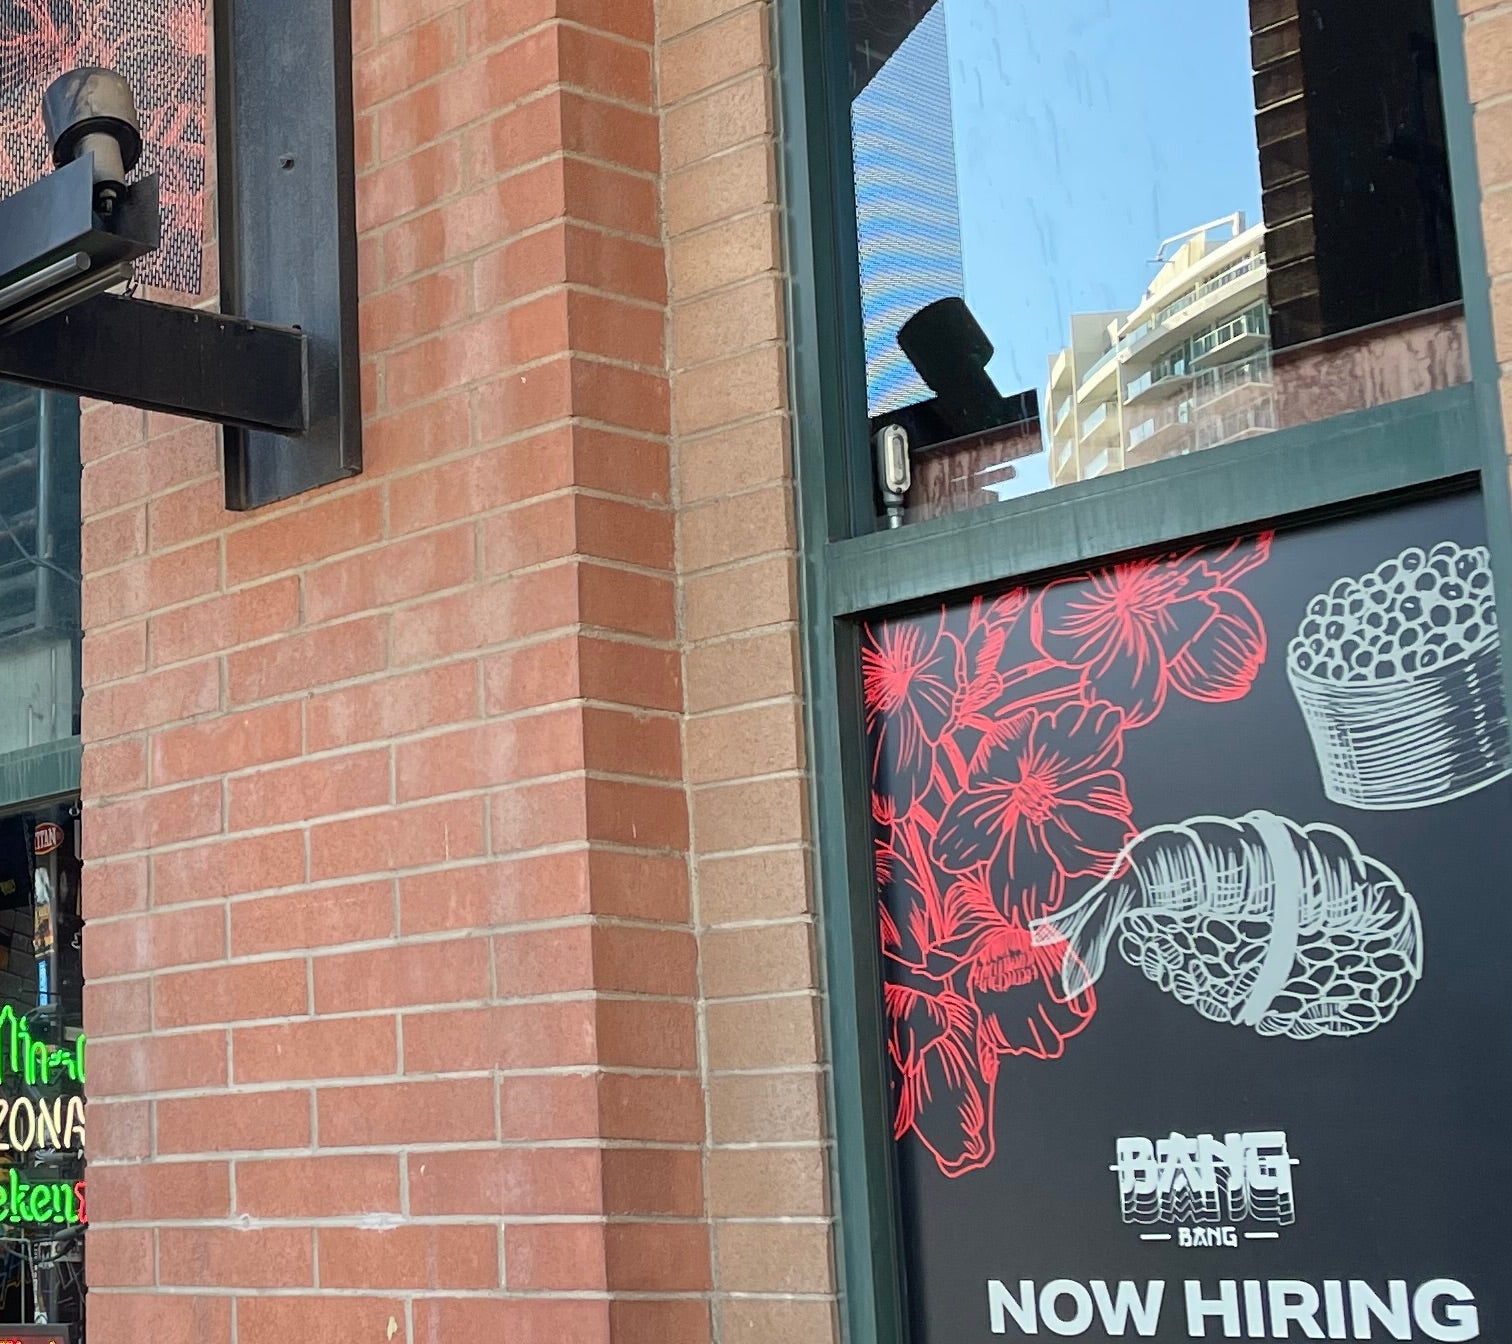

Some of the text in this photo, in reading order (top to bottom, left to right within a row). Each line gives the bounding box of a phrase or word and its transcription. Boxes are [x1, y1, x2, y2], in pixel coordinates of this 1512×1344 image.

[1115, 1131, 1295, 1225] BANG
[1178, 1226, 1238, 1247] BANG
[988, 1278, 1481, 1343] NOW HIRING
